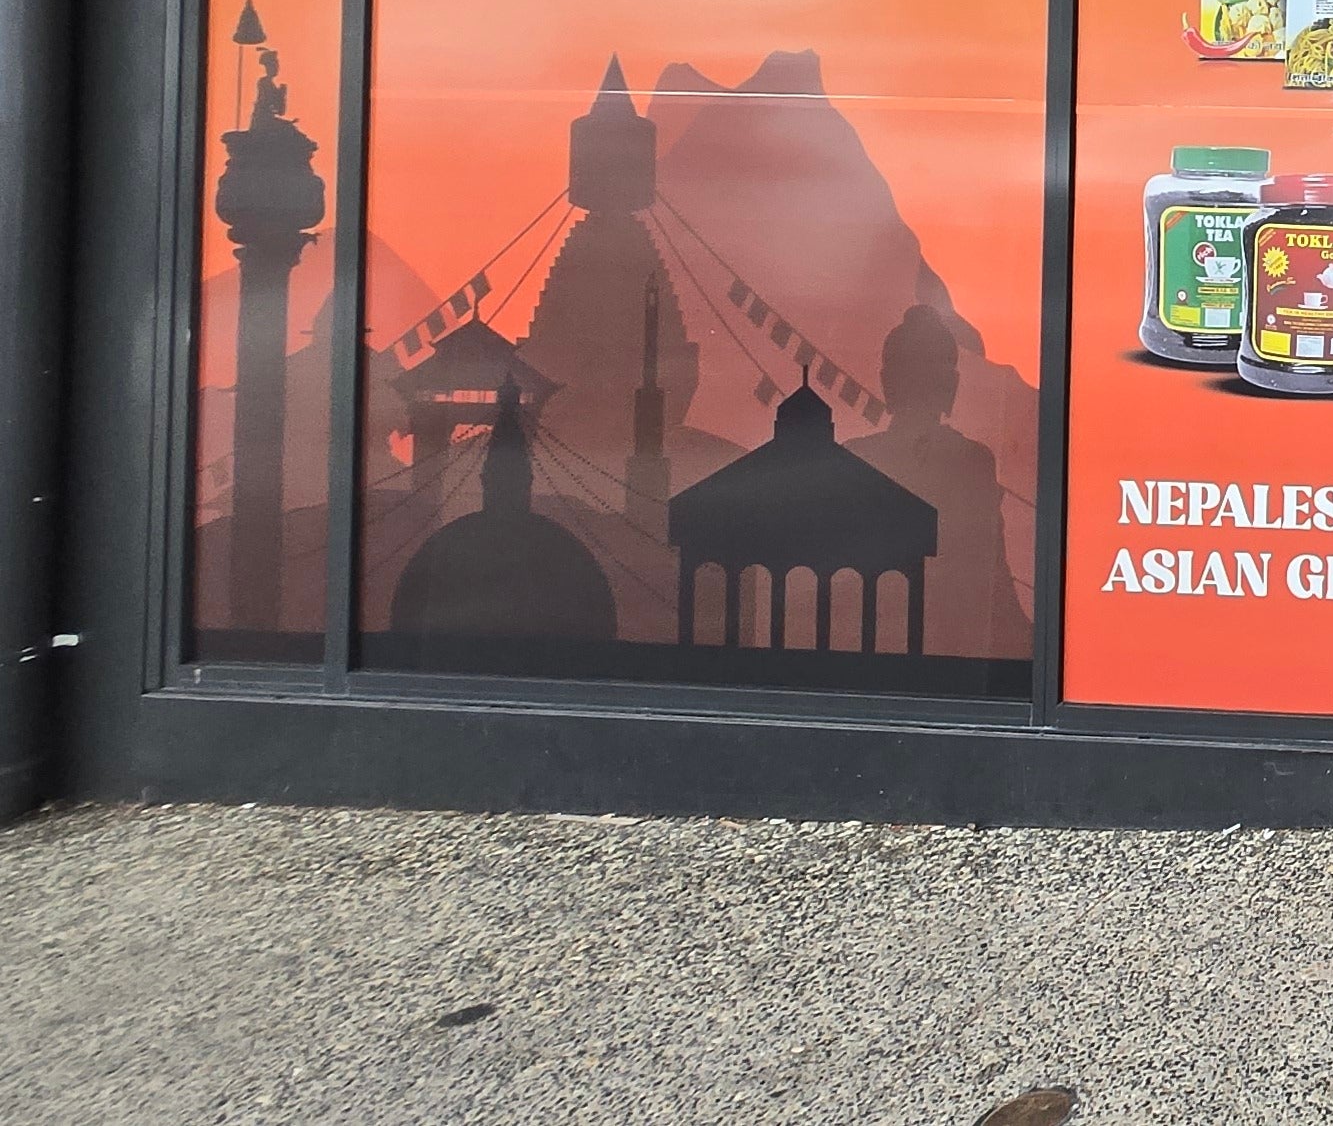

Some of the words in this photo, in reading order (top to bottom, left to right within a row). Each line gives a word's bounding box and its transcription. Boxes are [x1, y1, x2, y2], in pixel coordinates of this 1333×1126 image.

[1195, 214, 1245, 229] TOKLA
[1206, 229, 1234, 242] TEA
[1101, 547, 1272, 598] ASIAN
